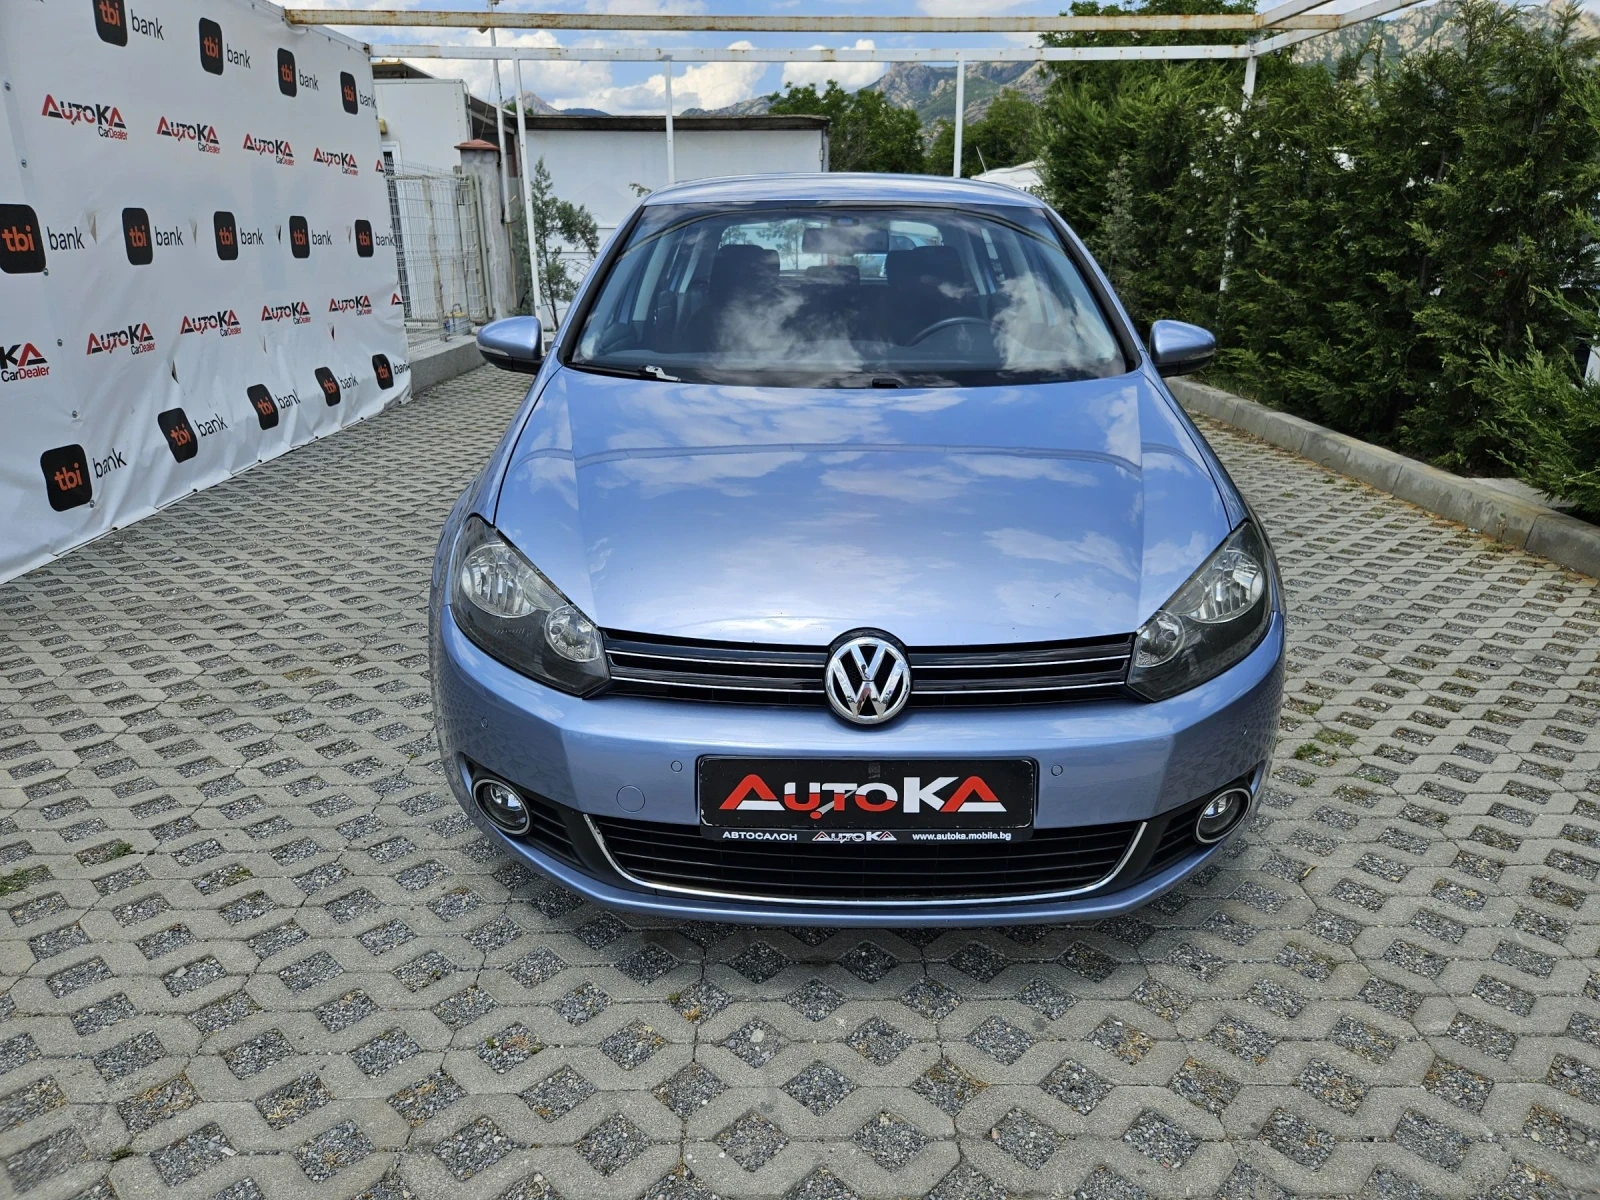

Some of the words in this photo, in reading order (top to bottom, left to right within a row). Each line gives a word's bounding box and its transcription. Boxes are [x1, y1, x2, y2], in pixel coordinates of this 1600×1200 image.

[100, 0, 120, 26] tbi
[131, 9, 164, 40] bank
[204, 37, 219, 59] tbi
[227, 43, 251, 69] bank
[281, 65, 293, 83] tbi
[299, 70, 319, 91] bank
[343, 85, 355, 102] tbi
[359, 89, 377, 109] bank
[98, 126, 128, 140] CarDealer
[2, 225, 35, 252] tbi
[47, 226, 85, 251] bank
[129, 225, 147, 247] tbi
[154, 226, 184, 247] bank
[219, 226, 234, 245] tbi
[240, 227, 264, 245] bank
[293, 226, 306, 245] tbi
[311, 230, 332, 245] bank
[359, 231, 370, 246] tbi
[375, 232, 396, 246] bank
[131, 342, 156, 355] CarDealer
[1, 366, 49, 382] CarDealer
[324, 377, 337, 394] tbi
[337, 373, 359, 390] bank
[257, 396, 274, 415] tbi
[170, 422, 192, 446] tbi
[194, 413, 228, 437] bank
[54, 462, 82, 491] tbi
[92, 448, 127, 478] bank
[831, 640, 906, 718] VW
[718, 774, 1007, 819] AUTOKA
[722, 831, 798, 841] АВТОСАЛОН
[912, 831, 1012, 842] www.autoka.mobile.bg
